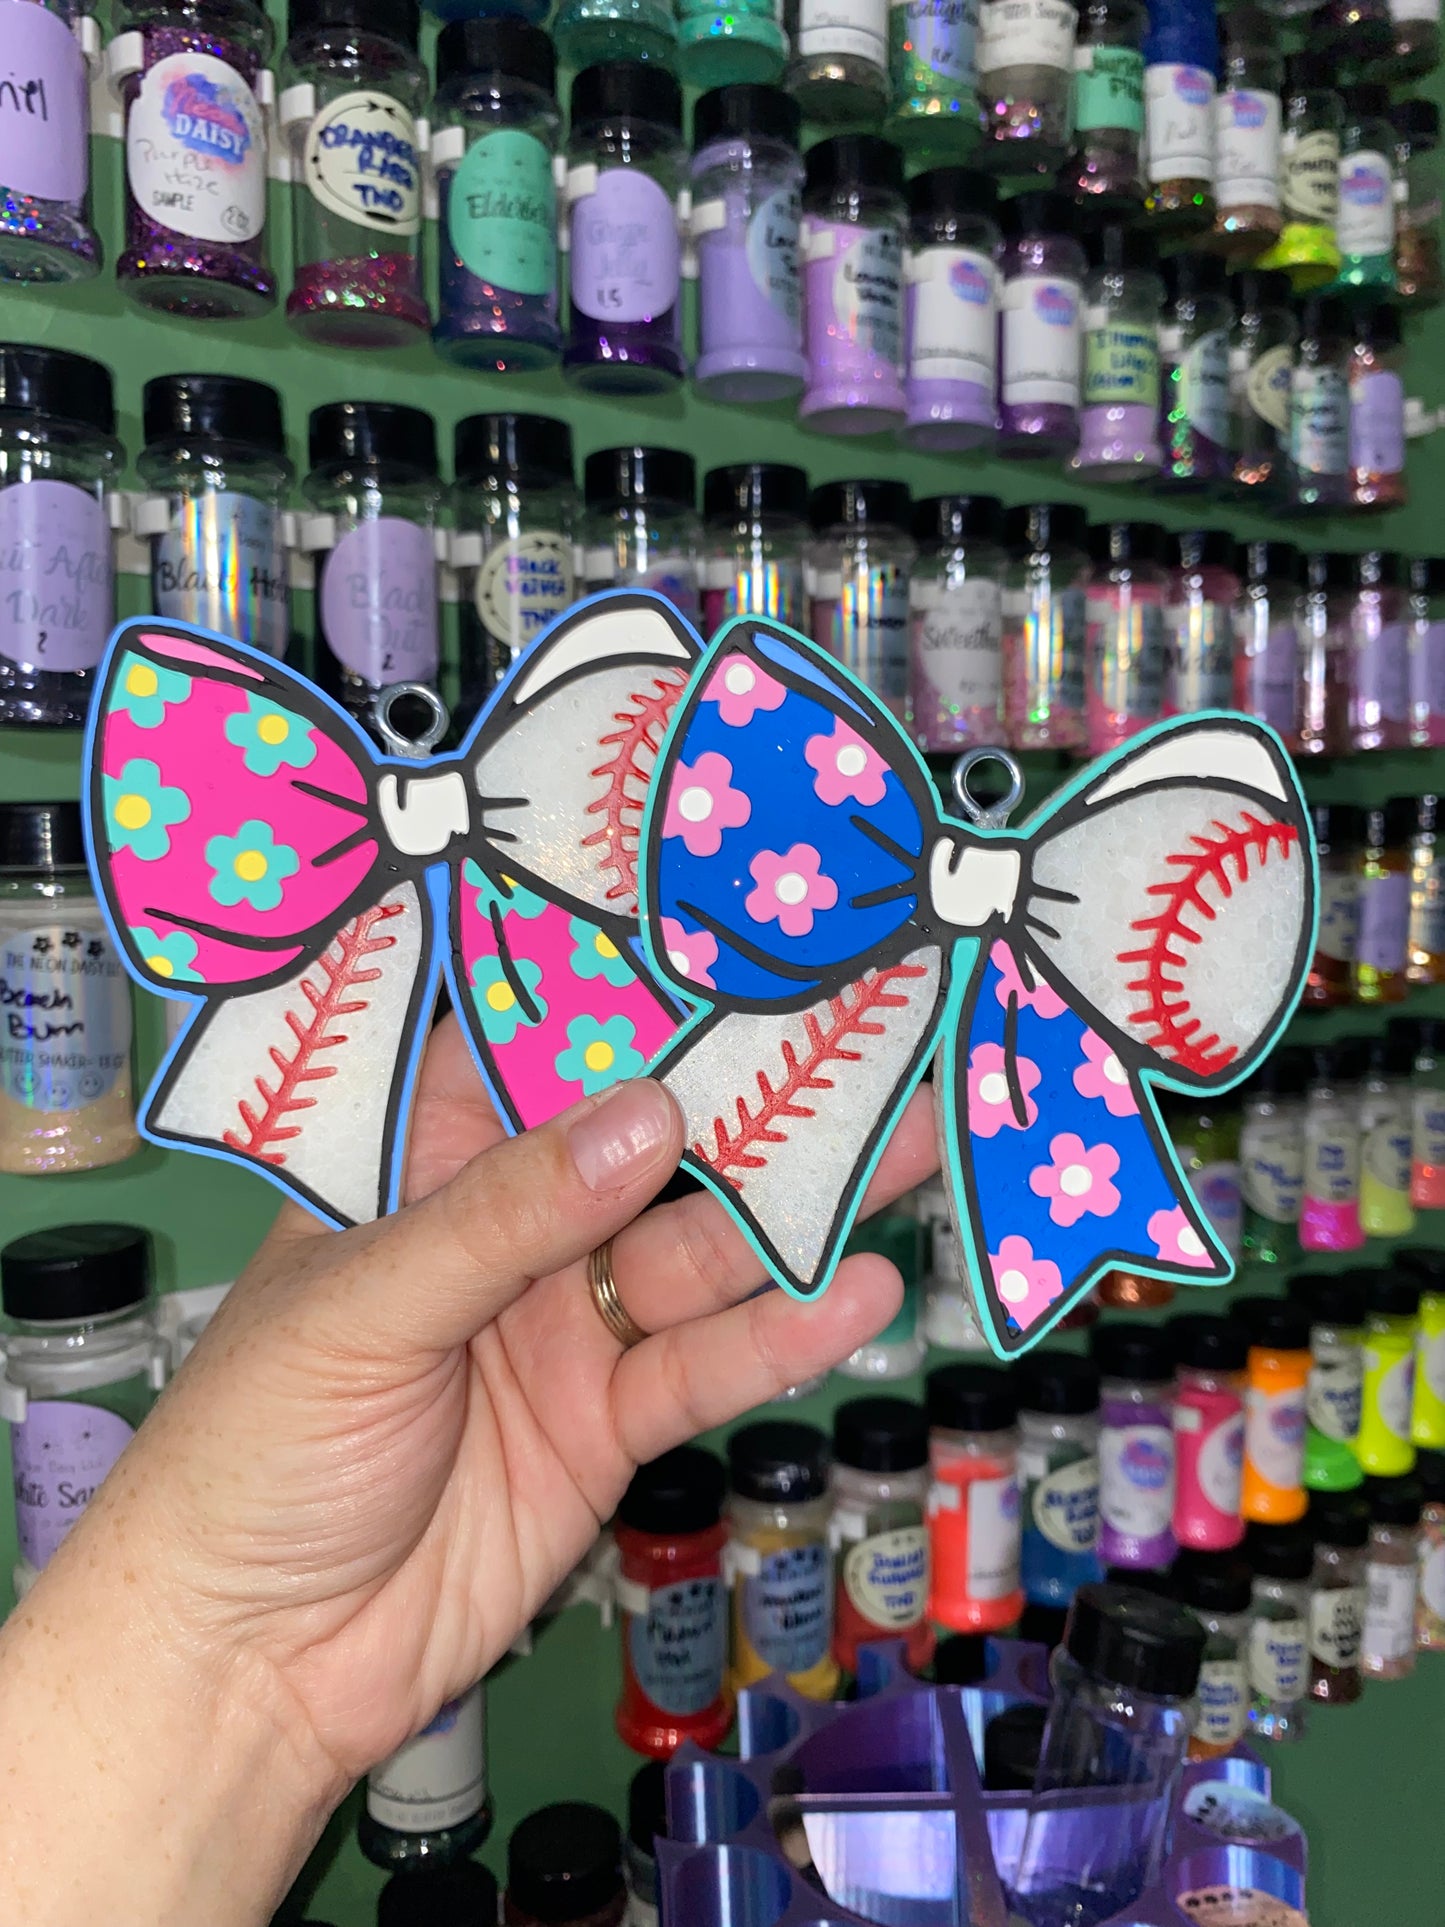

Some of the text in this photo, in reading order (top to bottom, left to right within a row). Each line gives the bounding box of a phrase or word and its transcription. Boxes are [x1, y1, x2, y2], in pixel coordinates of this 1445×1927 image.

[174, 113, 246, 155] DAISY
[30, 956, 67, 974] NEON
[8, 1012, 85, 1042] Bum
